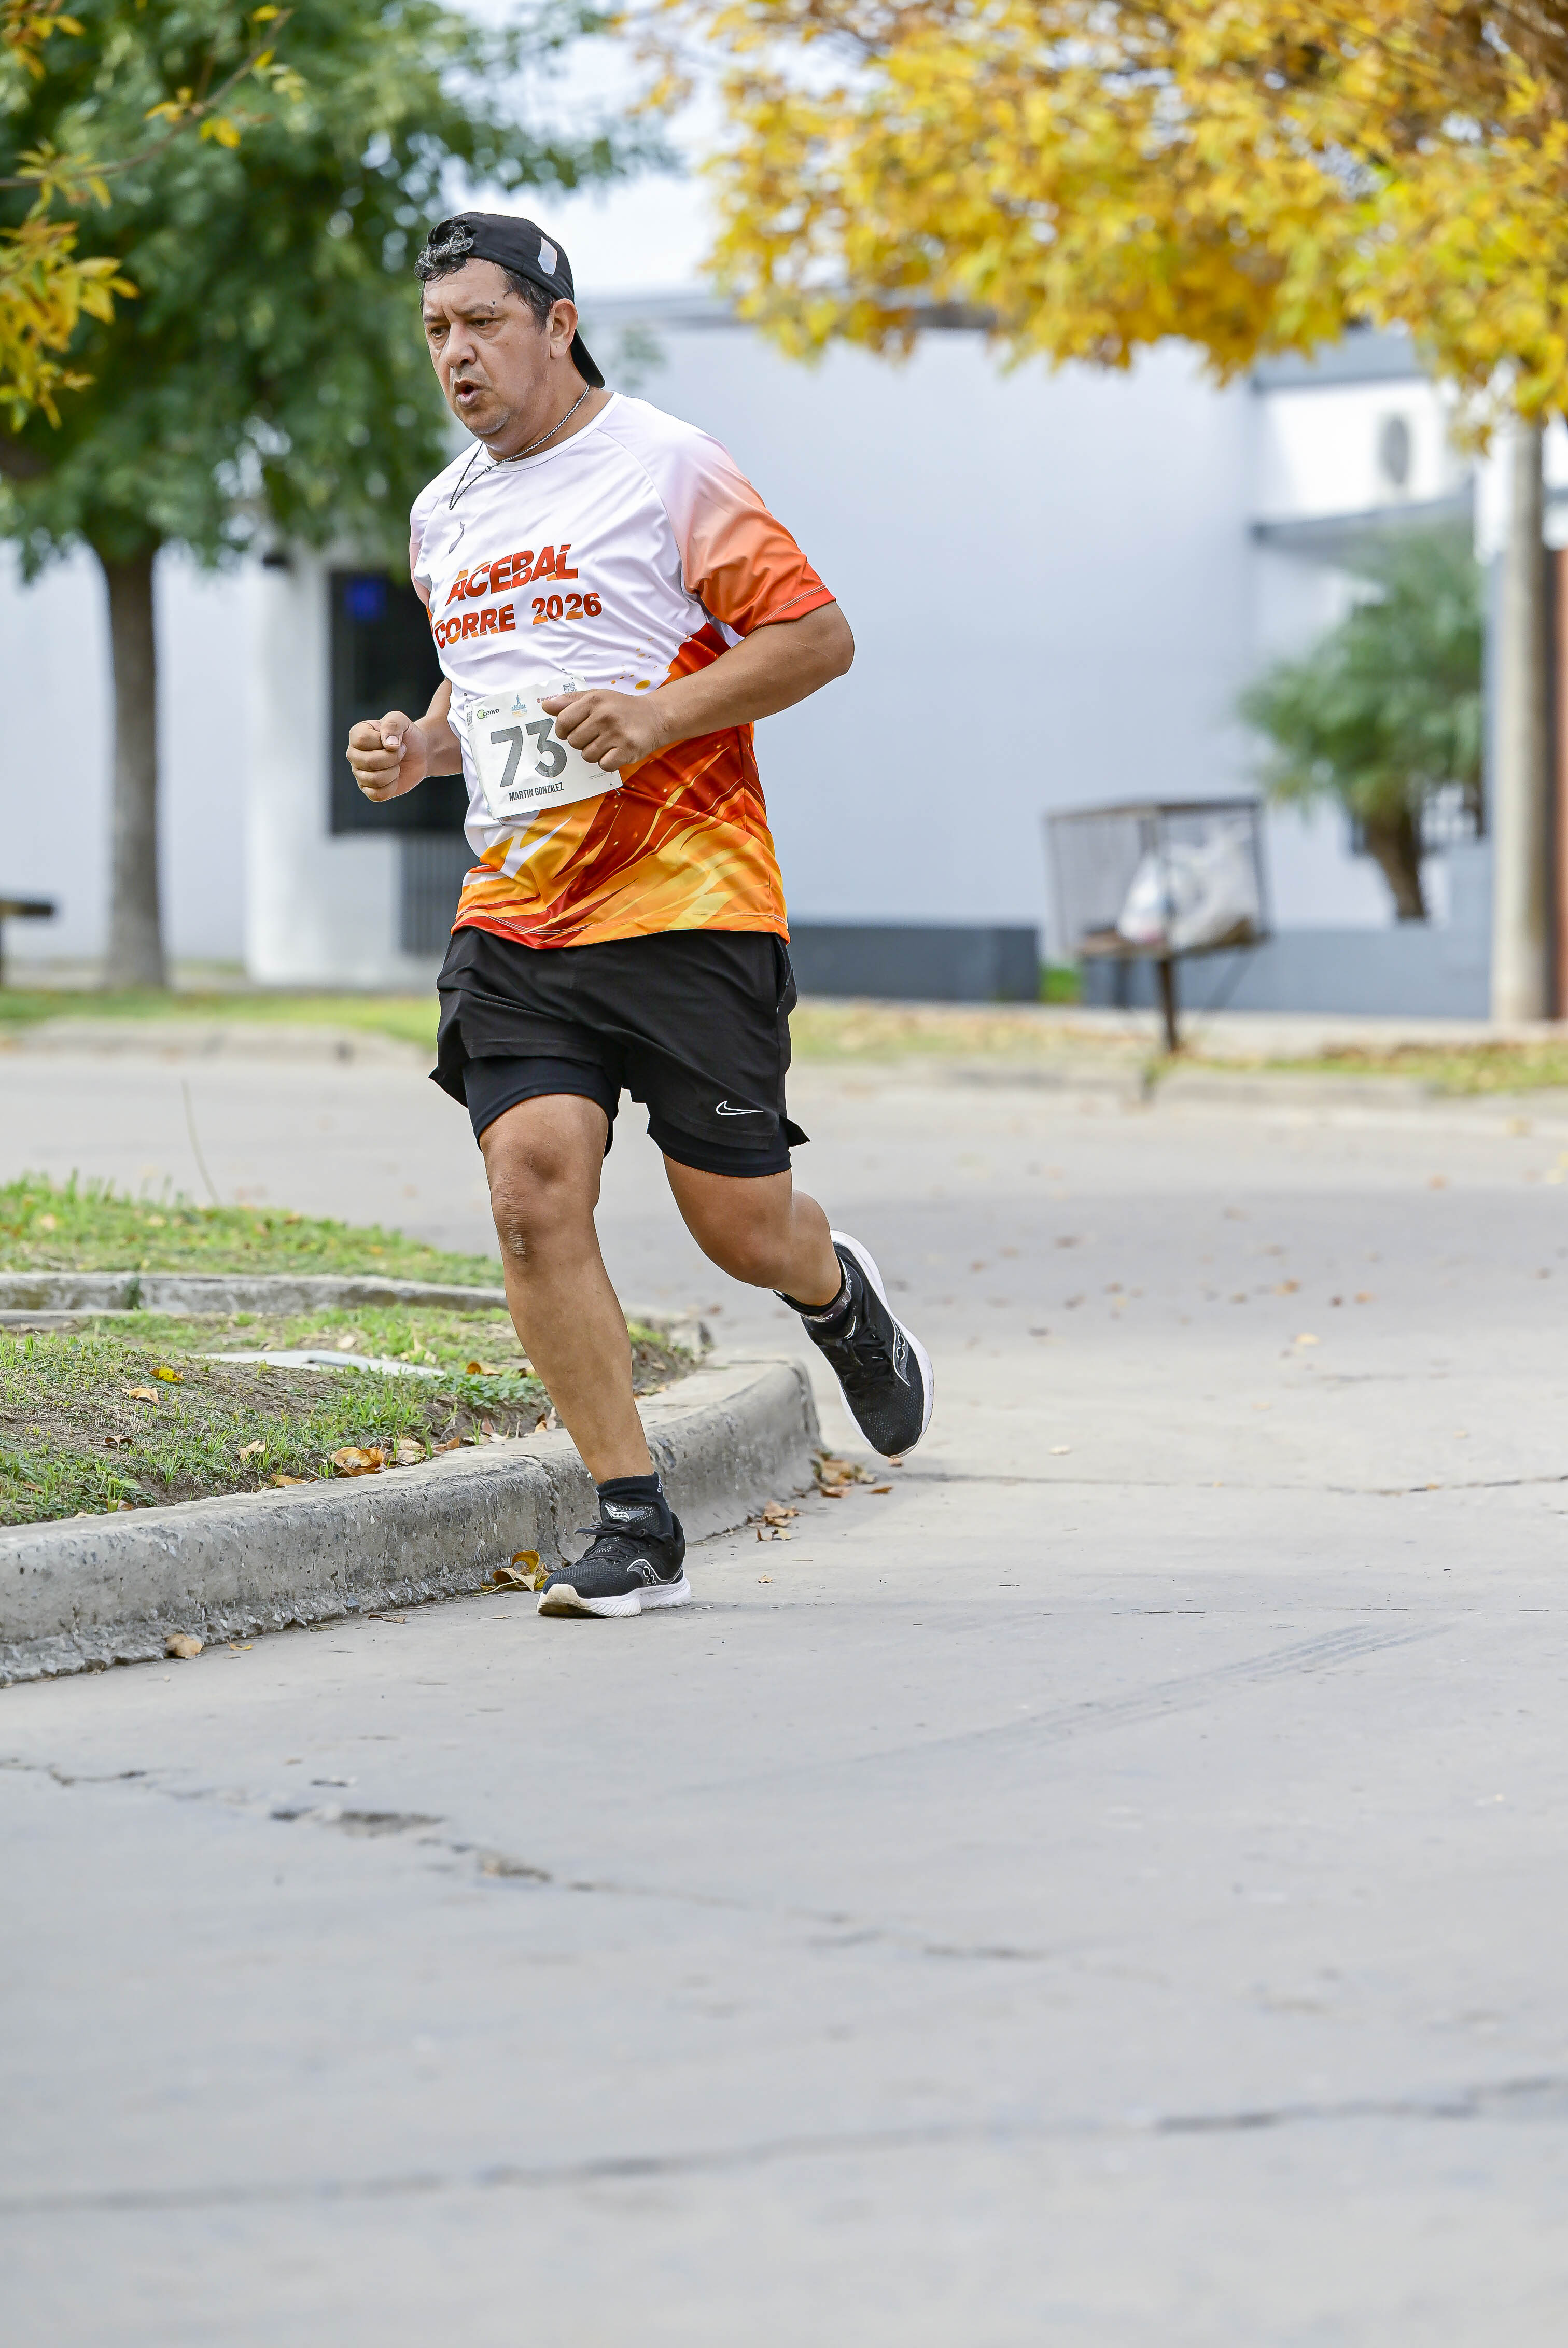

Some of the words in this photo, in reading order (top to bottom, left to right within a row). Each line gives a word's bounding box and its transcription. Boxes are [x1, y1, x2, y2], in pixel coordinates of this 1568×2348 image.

[445, 544, 578, 606] ACEBAL
[435, 603, 516, 649] CORRE
[532, 592, 602, 625] 2026
[491, 718, 567, 787] 73
[509, 788, 534, 801] MARTIN
